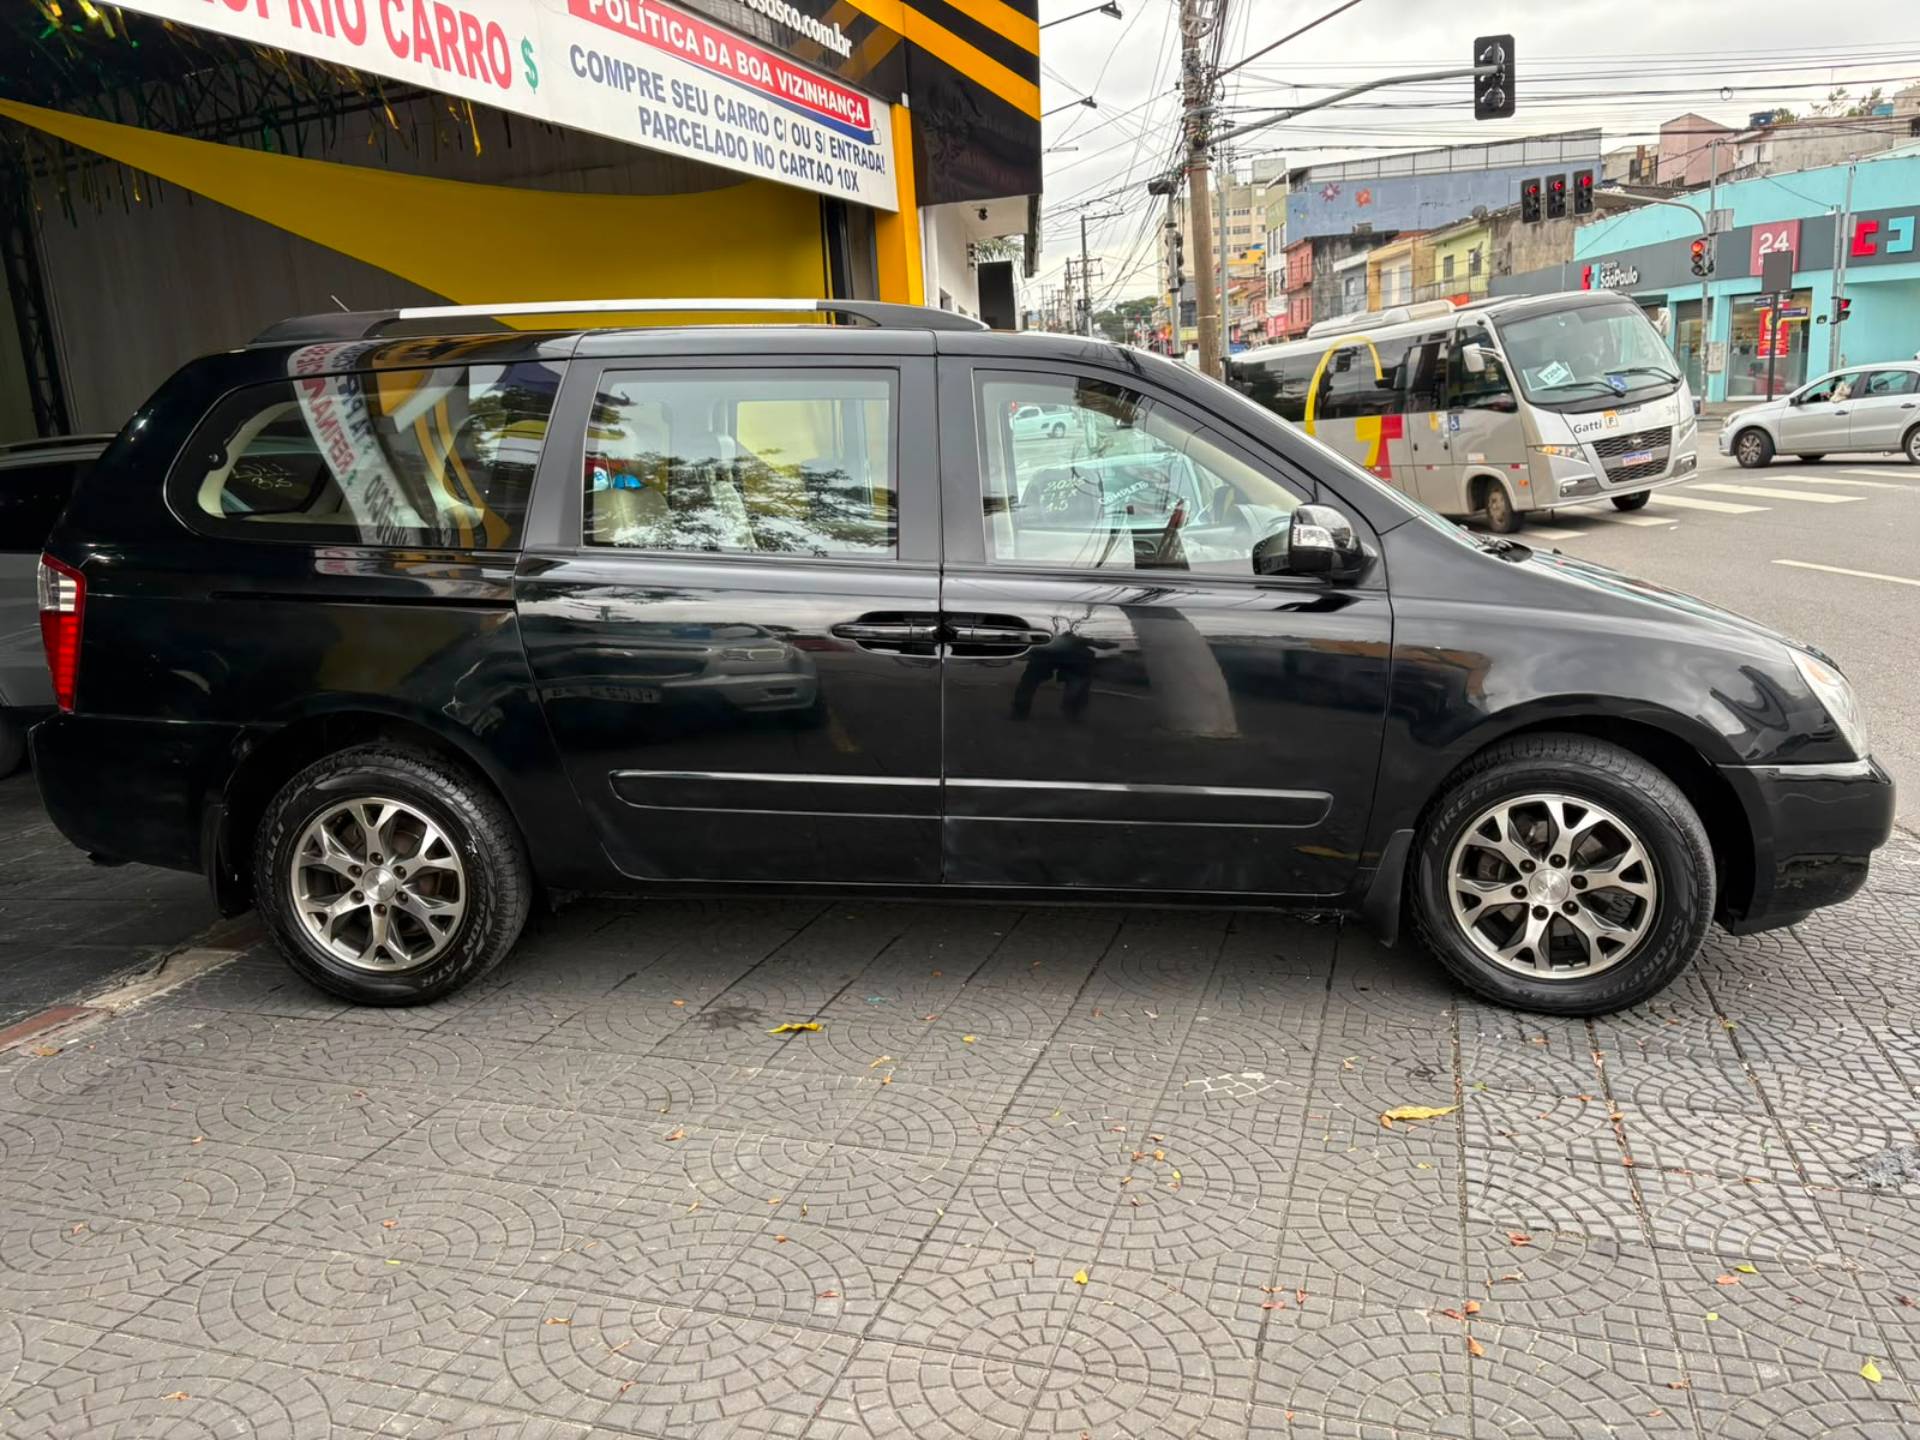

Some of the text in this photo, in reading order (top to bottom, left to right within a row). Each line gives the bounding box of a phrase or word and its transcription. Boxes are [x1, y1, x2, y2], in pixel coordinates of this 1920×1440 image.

[379, 0, 512, 90] CARRO
[520, 35, 539, 95] $
[702, 35, 733, 70] DA
[736, 51, 774, 87] BOA
[776, 69, 866, 126] VIZINHANÇA
[569, 44, 666, 104] COMPRE
[671, 78, 710, 117] SEU
[714, 94, 770, 137] CARRO
[791, 119, 812, 150] OU
[829, 137, 886, 176] ENTRADA!
[638, 105, 749, 163] PARCELADO
[752, 140, 775, 170] NO
[837, 166, 860, 193] 10X
[1758, 230, 1790, 255] 24
[1573, 419, 1603, 435] Gatti
[1430, 775, 1510, 847] PIRELLI
